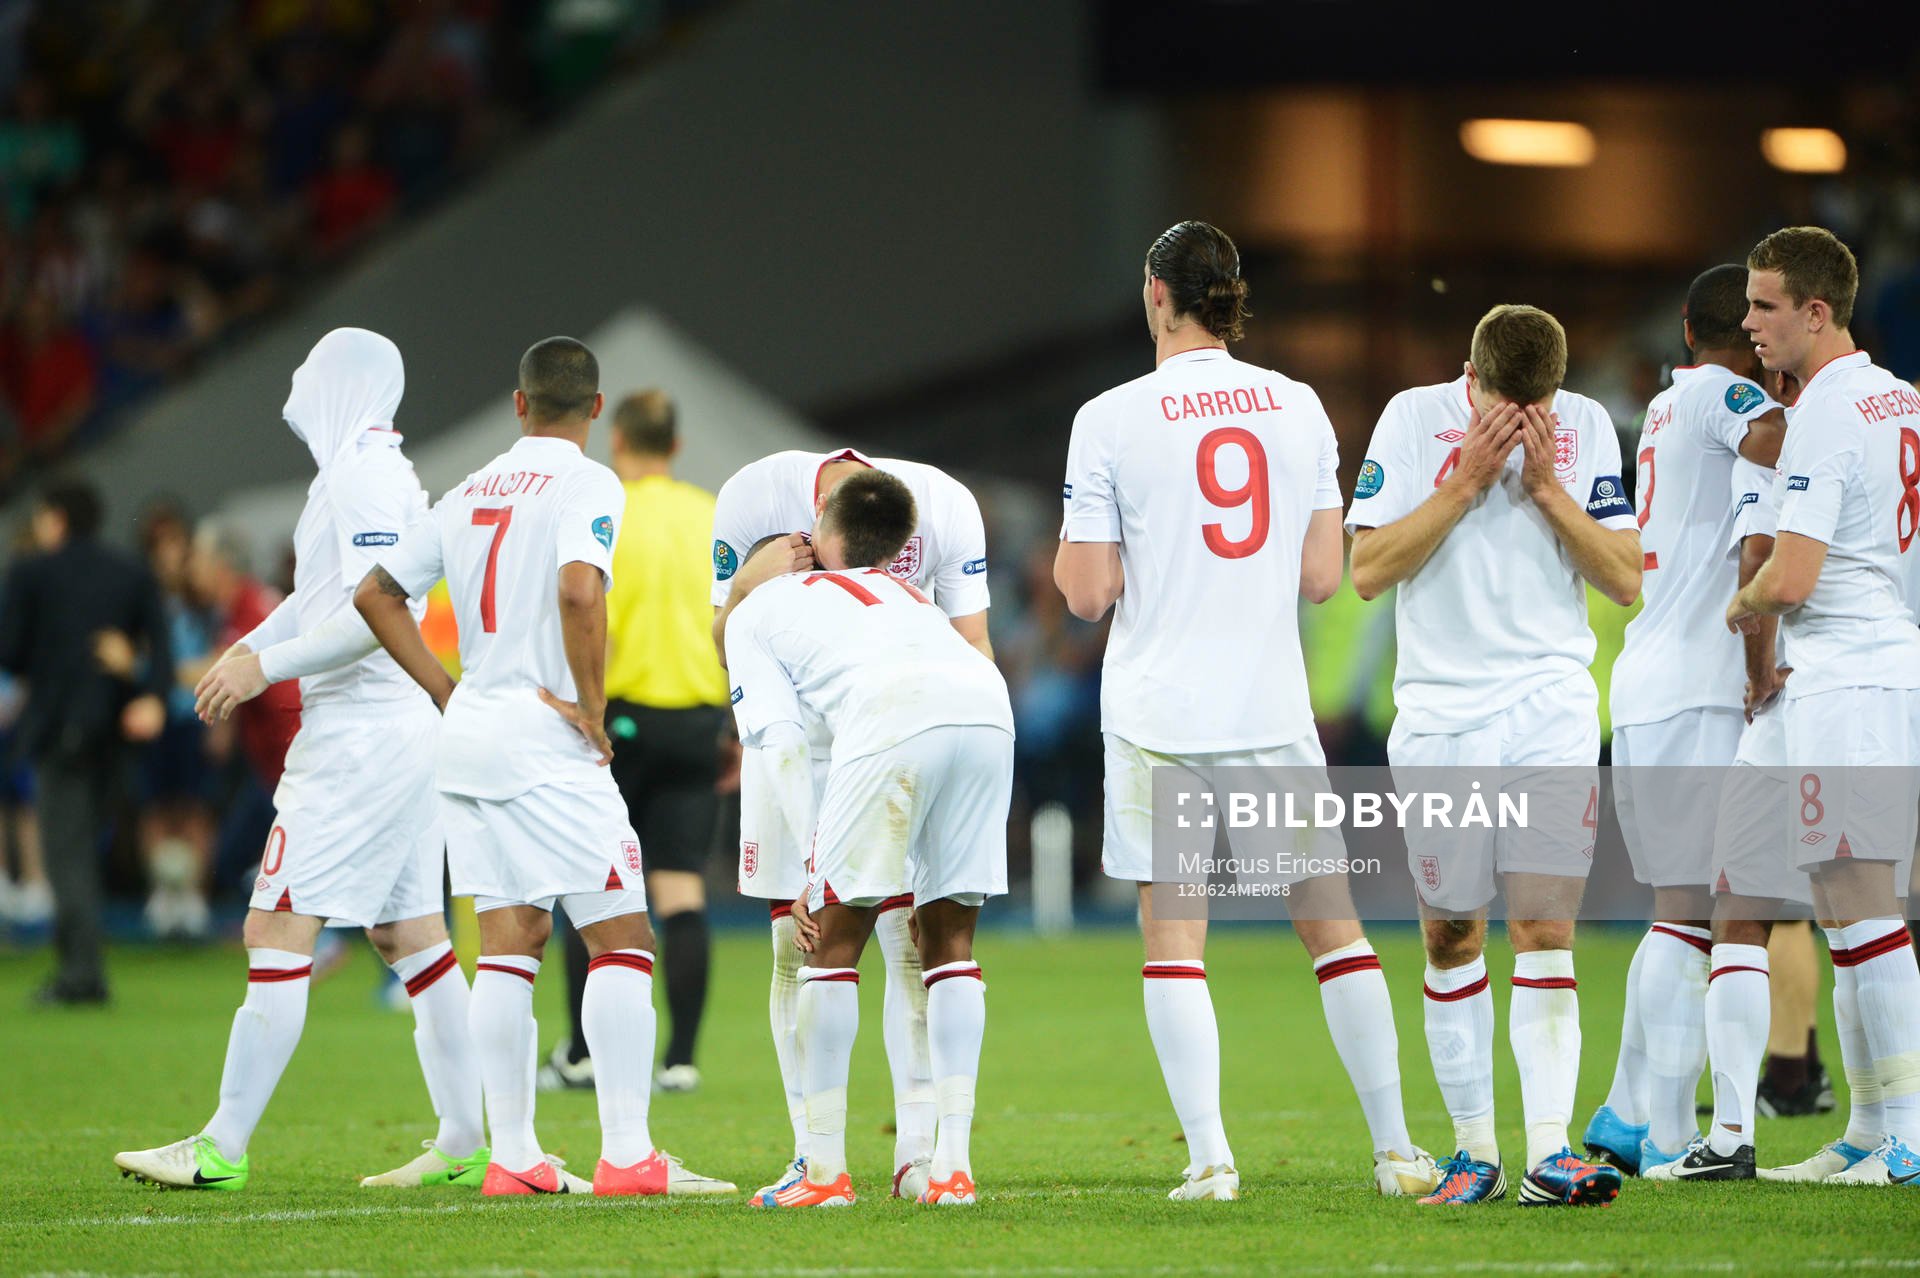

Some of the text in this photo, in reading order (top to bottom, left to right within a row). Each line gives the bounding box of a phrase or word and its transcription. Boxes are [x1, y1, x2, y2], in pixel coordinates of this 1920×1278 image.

[1160, 386, 1283, 422] CARROLL
[1196, 427, 1271, 560] 9
[1587, 497, 1627, 511] RESPECT
[1896, 426, 1920, 554] 8
[364, 534, 399, 545] RESPECT
[471, 504, 514, 634] 7
[1582, 786, 1598, 841] 4
[1800, 774, 1825, 827] 8
